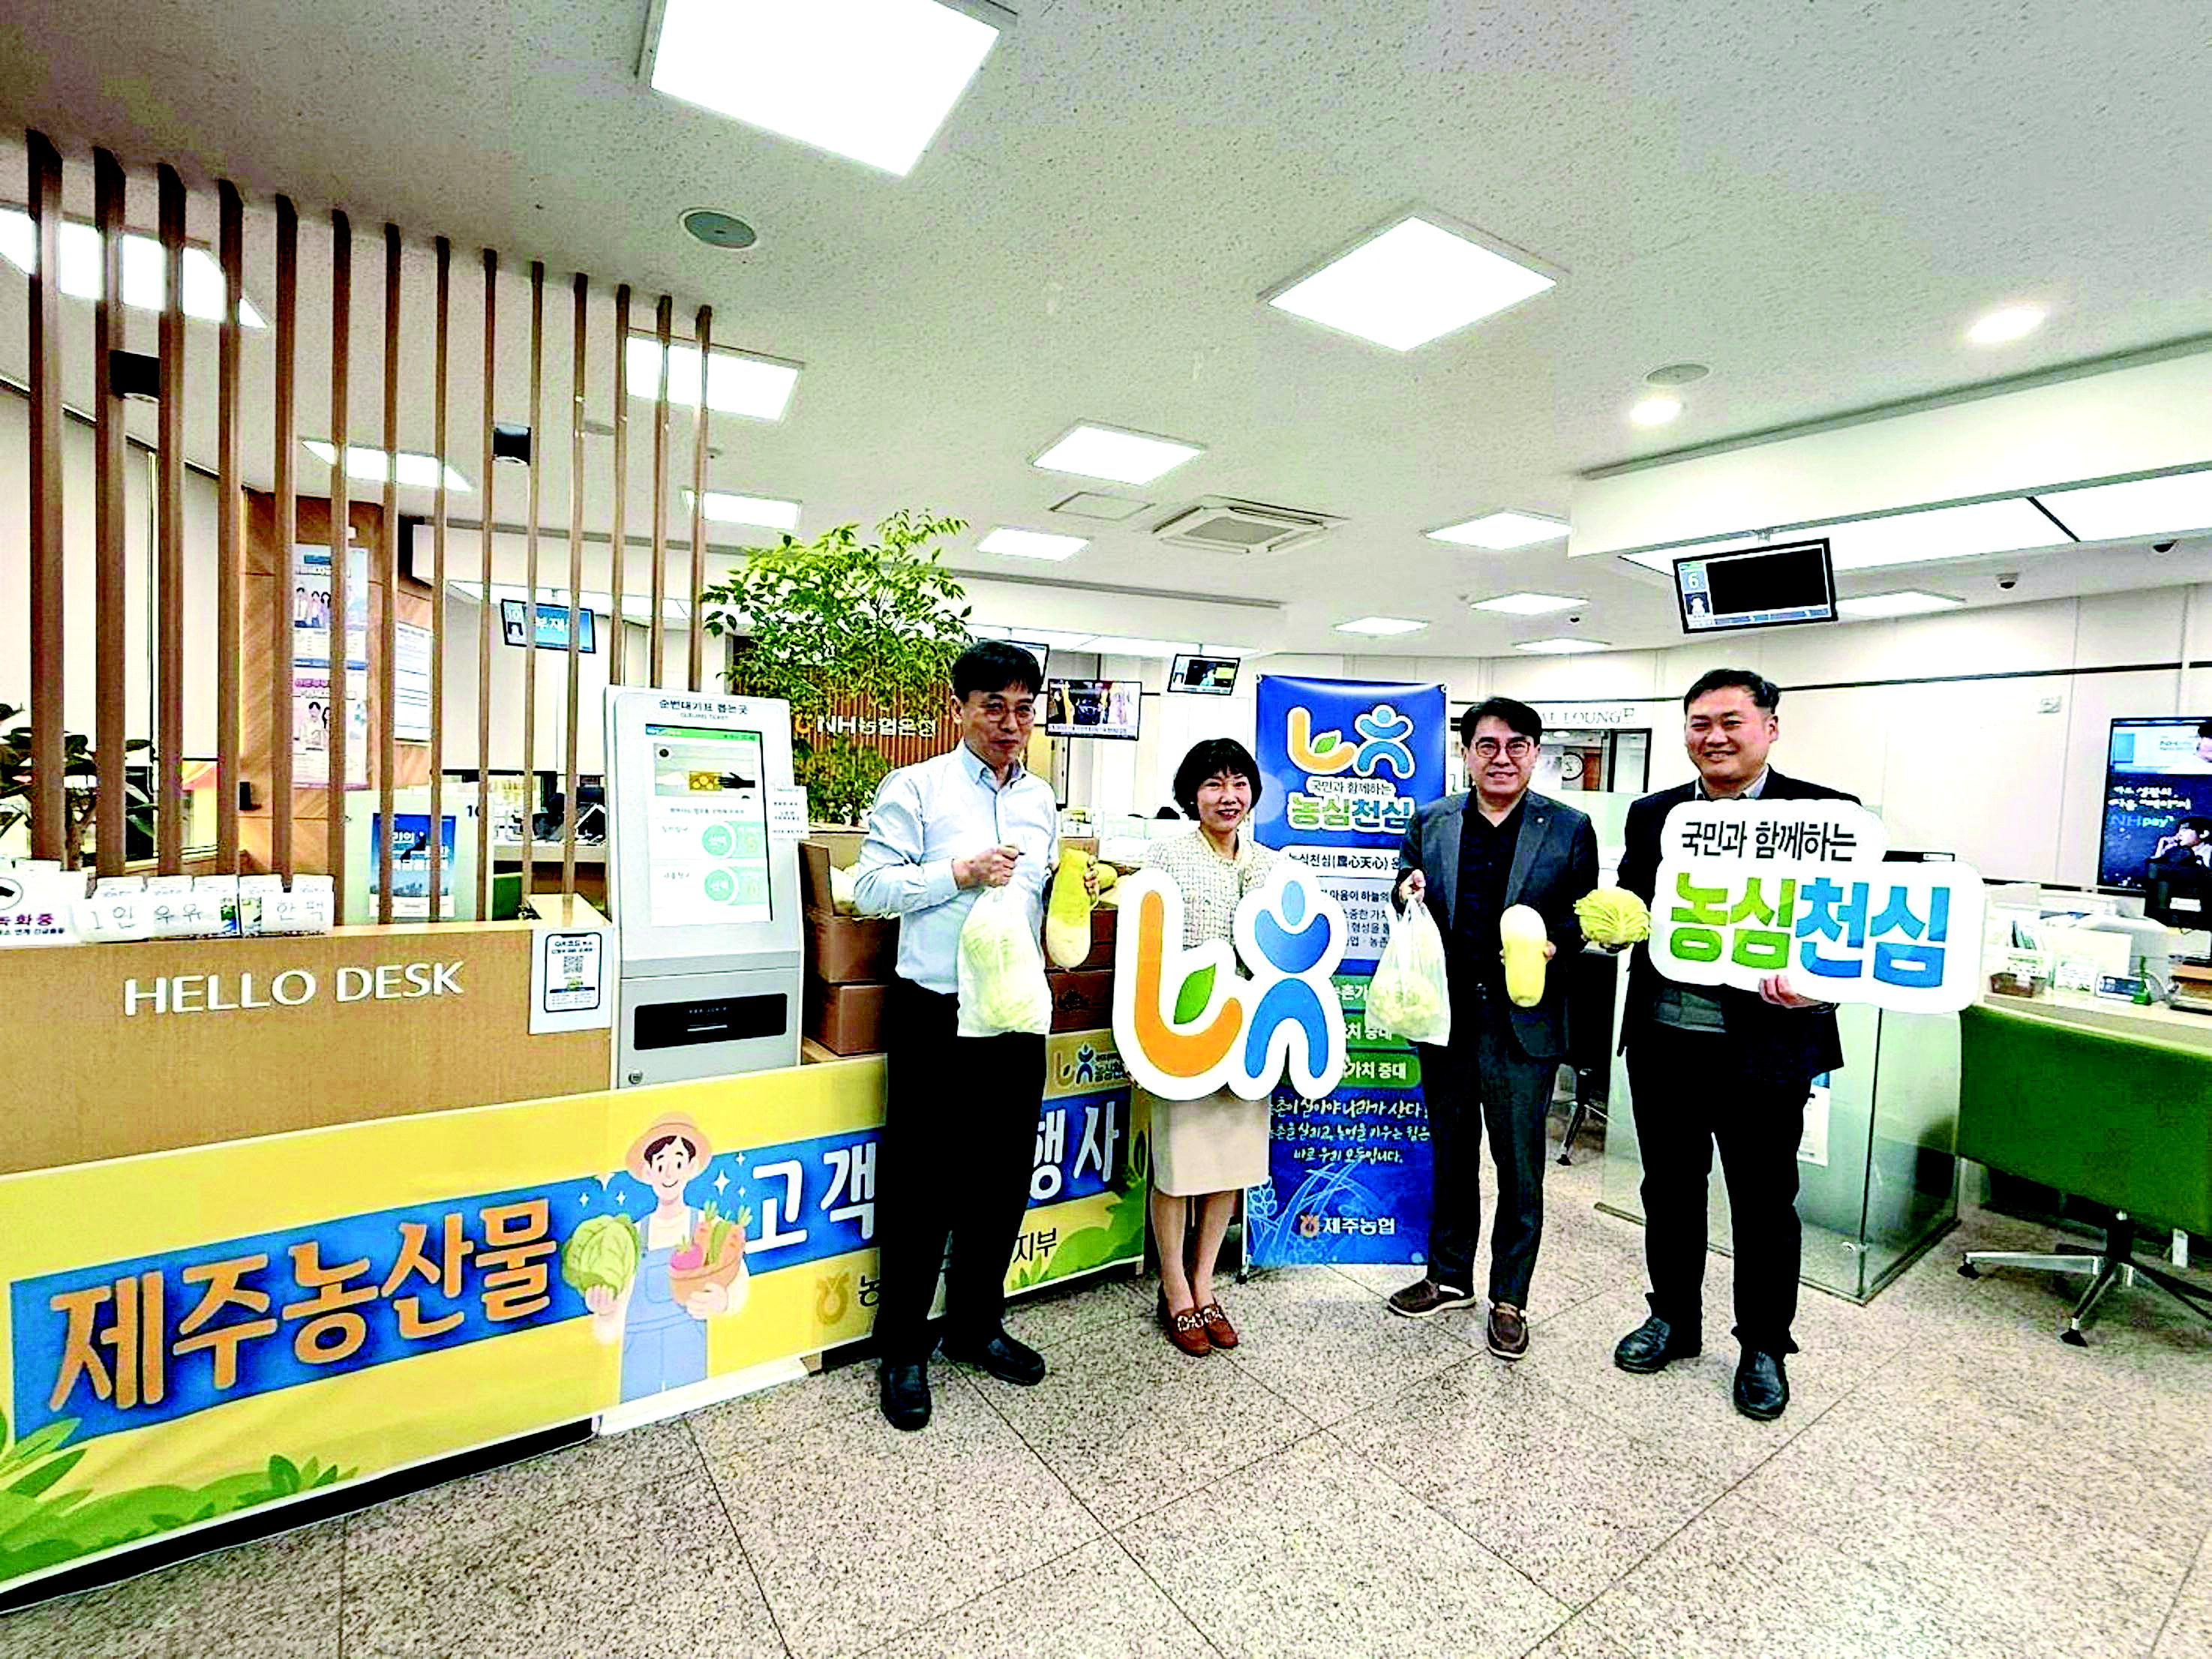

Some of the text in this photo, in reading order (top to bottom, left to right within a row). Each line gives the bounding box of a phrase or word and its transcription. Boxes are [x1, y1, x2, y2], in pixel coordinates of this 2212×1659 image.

[1688, 572, 1699, 589] 6
[1312, 779, 1343, 794] 국민과
[1292, 796, 1410, 829] 농심천심
[1682, 820, 1856, 862] 국민과 함께하는
[154, 903, 203, 924] 우유
[1670, 872, 1950, 988] 농심천심
[124, 961, 465, 1017] HELLO DESK
[1378, 1061, 1406, 1079] 증대
[745, 1141, 877, 1256] 고객
[1323, 1217, 1395, 1236] 제주농협
[48, 1198, 558, 1413] 제주농산물
